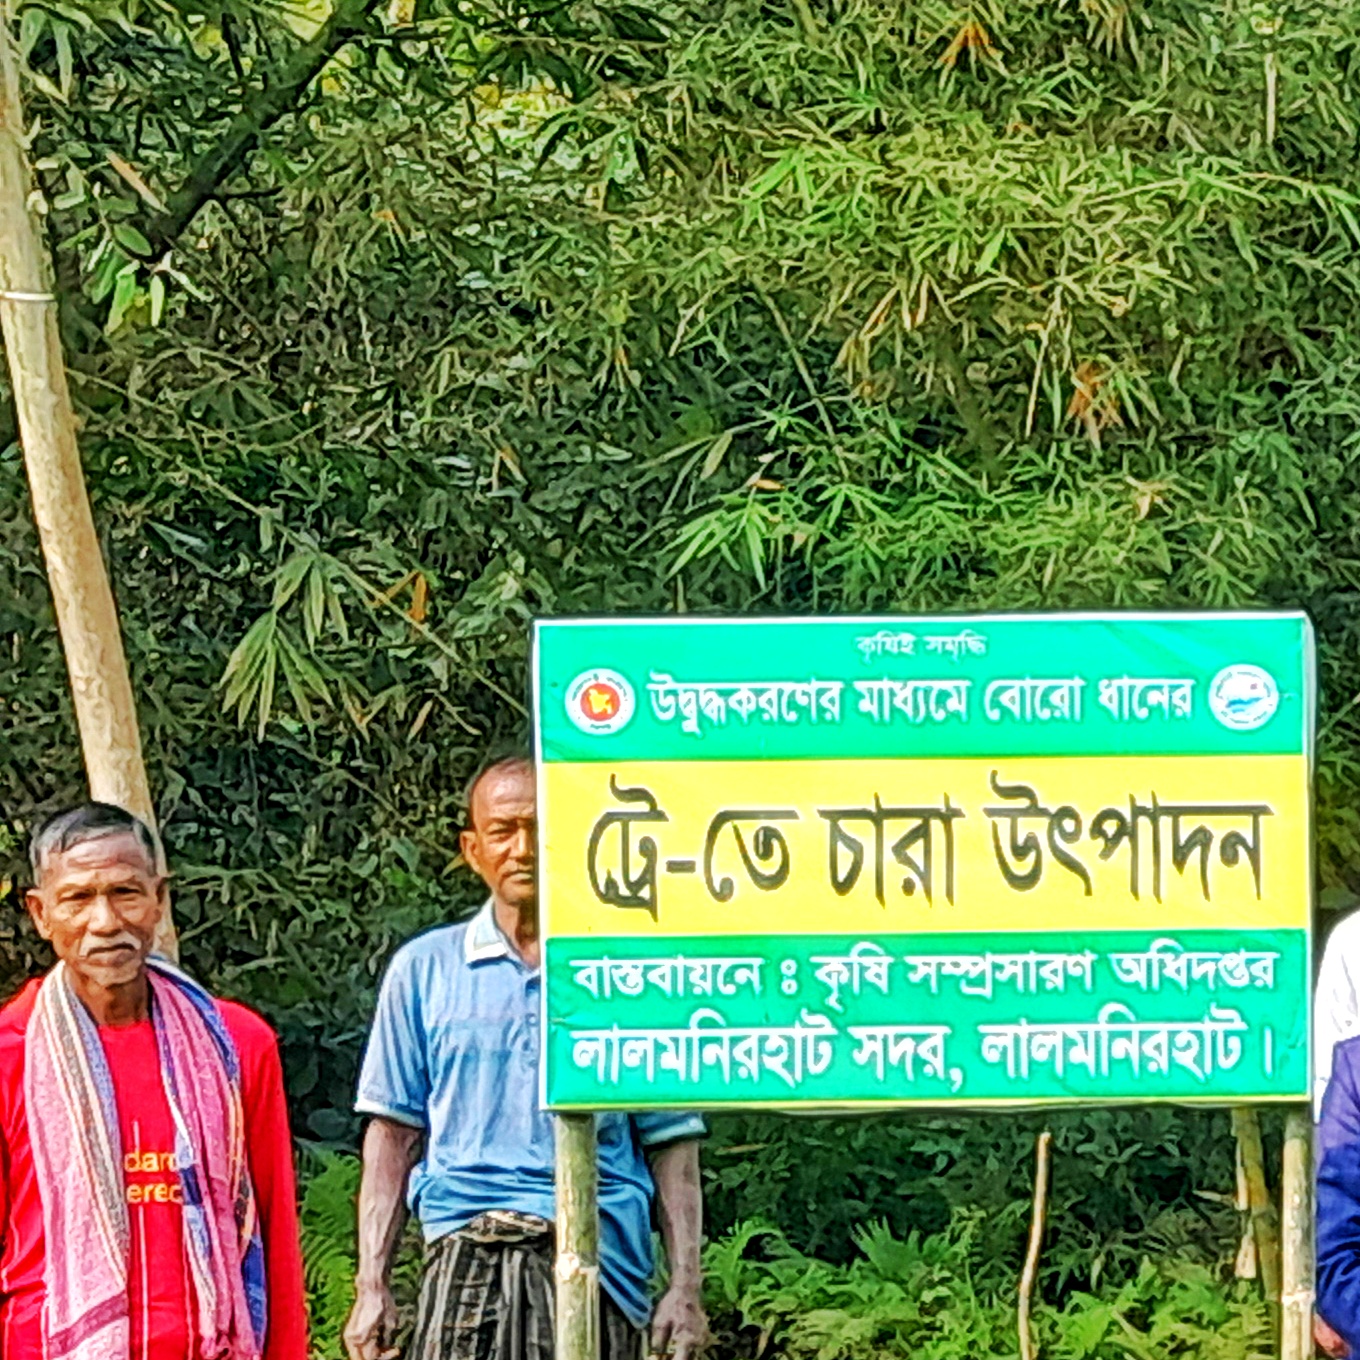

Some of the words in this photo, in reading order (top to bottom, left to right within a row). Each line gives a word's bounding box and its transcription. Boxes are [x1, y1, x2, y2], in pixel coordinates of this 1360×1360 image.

[853, 676, 972, 723] মাধ্যমে
[984, 676, 1087, 722] বোরো
[1098, 675, 1196, 721] ধানের
[588, 773, 800, 923] ট্রে-তে
[816, 792, 966, 908] চারা
[983, 770, 1275, 904] উৎপাদন
[568, 954, 765, 999] বাস্তবায়নে
[809, 941, 894, 1013] কৃষি
[903, 950, 1098, 999] সম্প্রসারণ
[1107, 938, 1281, 992] অধিদপ্তর
[569, 1007, 838, 1088] লালমনিরহাট
[847, 1025, 963, 1093] সদর,
[976, 1002, 1249, 1083] লালমনিরহাট
